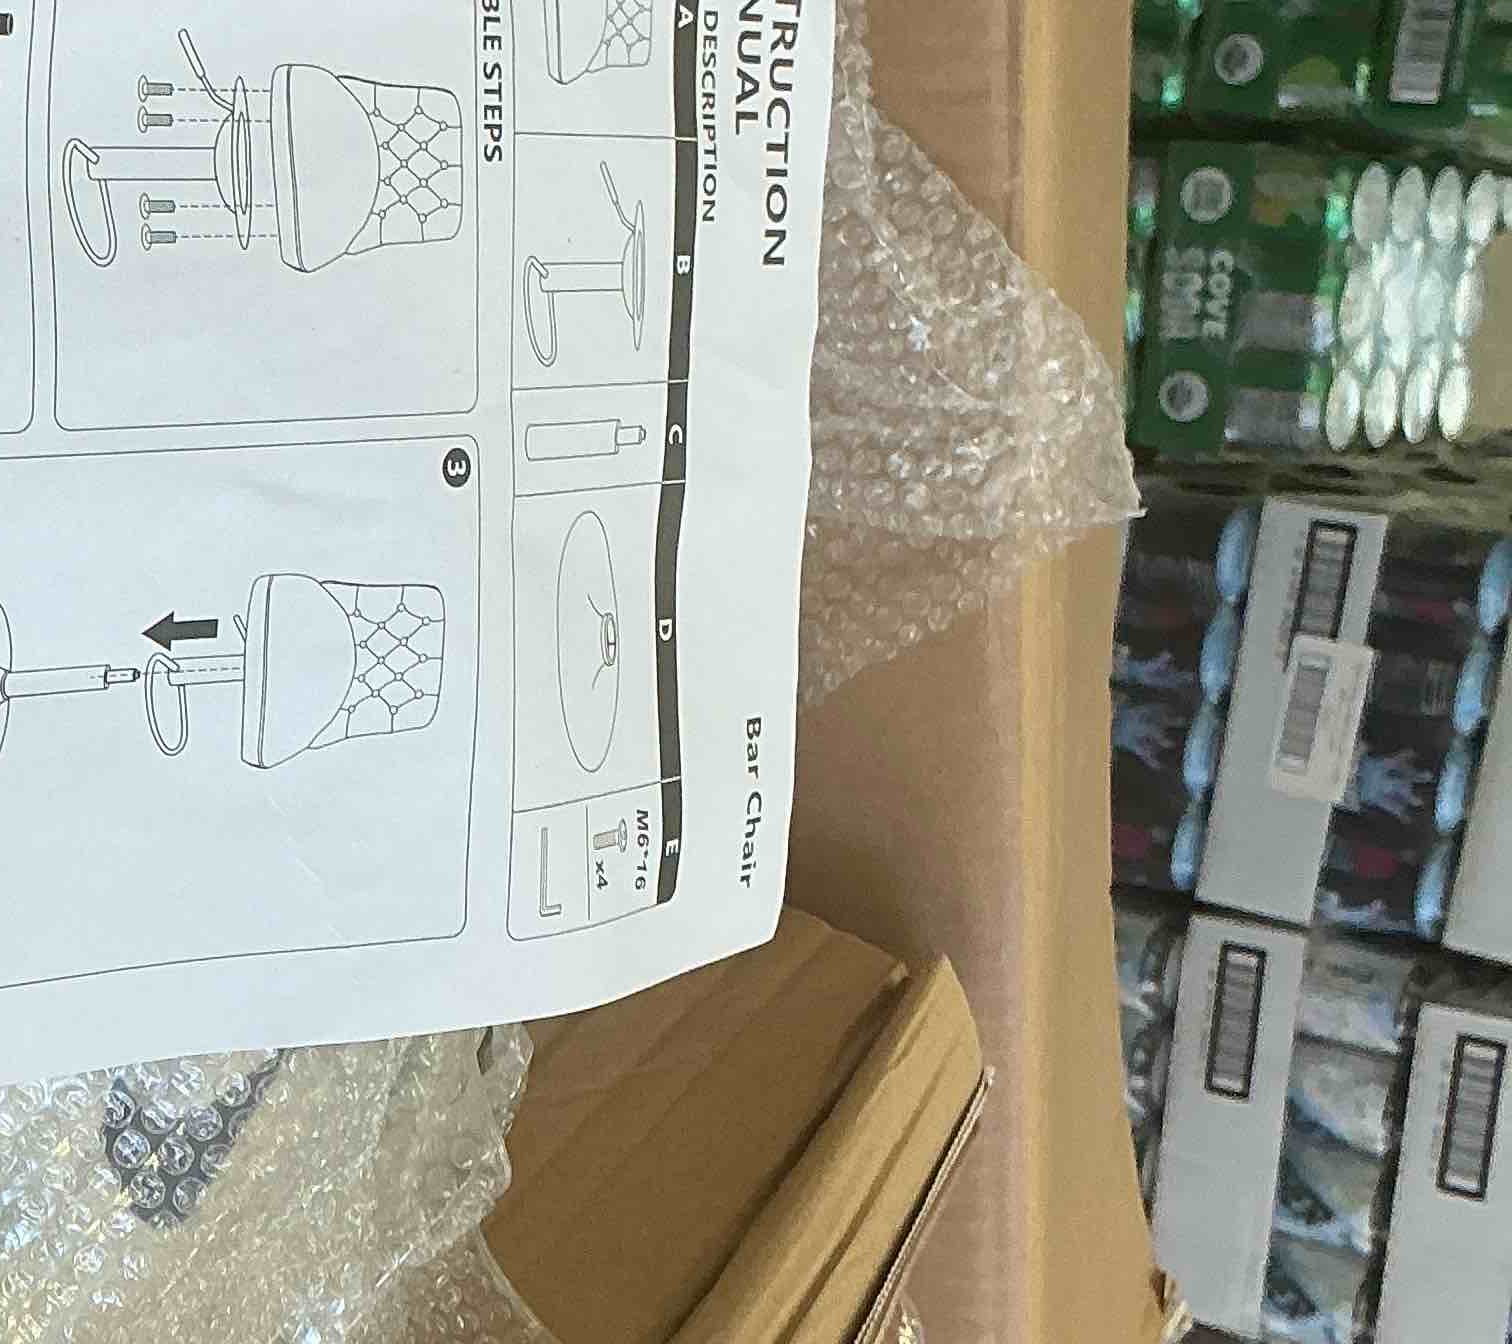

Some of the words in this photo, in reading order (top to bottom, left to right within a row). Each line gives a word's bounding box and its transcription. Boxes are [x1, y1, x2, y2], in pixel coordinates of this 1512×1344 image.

[676, 4, 693, 29] A
[482, 62, 502, 163] STEPS
[700, 10, 719, 222] DESCRIPTION
[675, 255, 690, 276] B
[1202, 251, 1233, 341] COVE
[667, 424, 682, 445] C
[657, 619, 672, 641] D
[744, 717, 762, 780] Bar
[663, 839, 678, 857] E
[738, 792, 762, 889] Chair
[593, 860, 607, 891] x4
